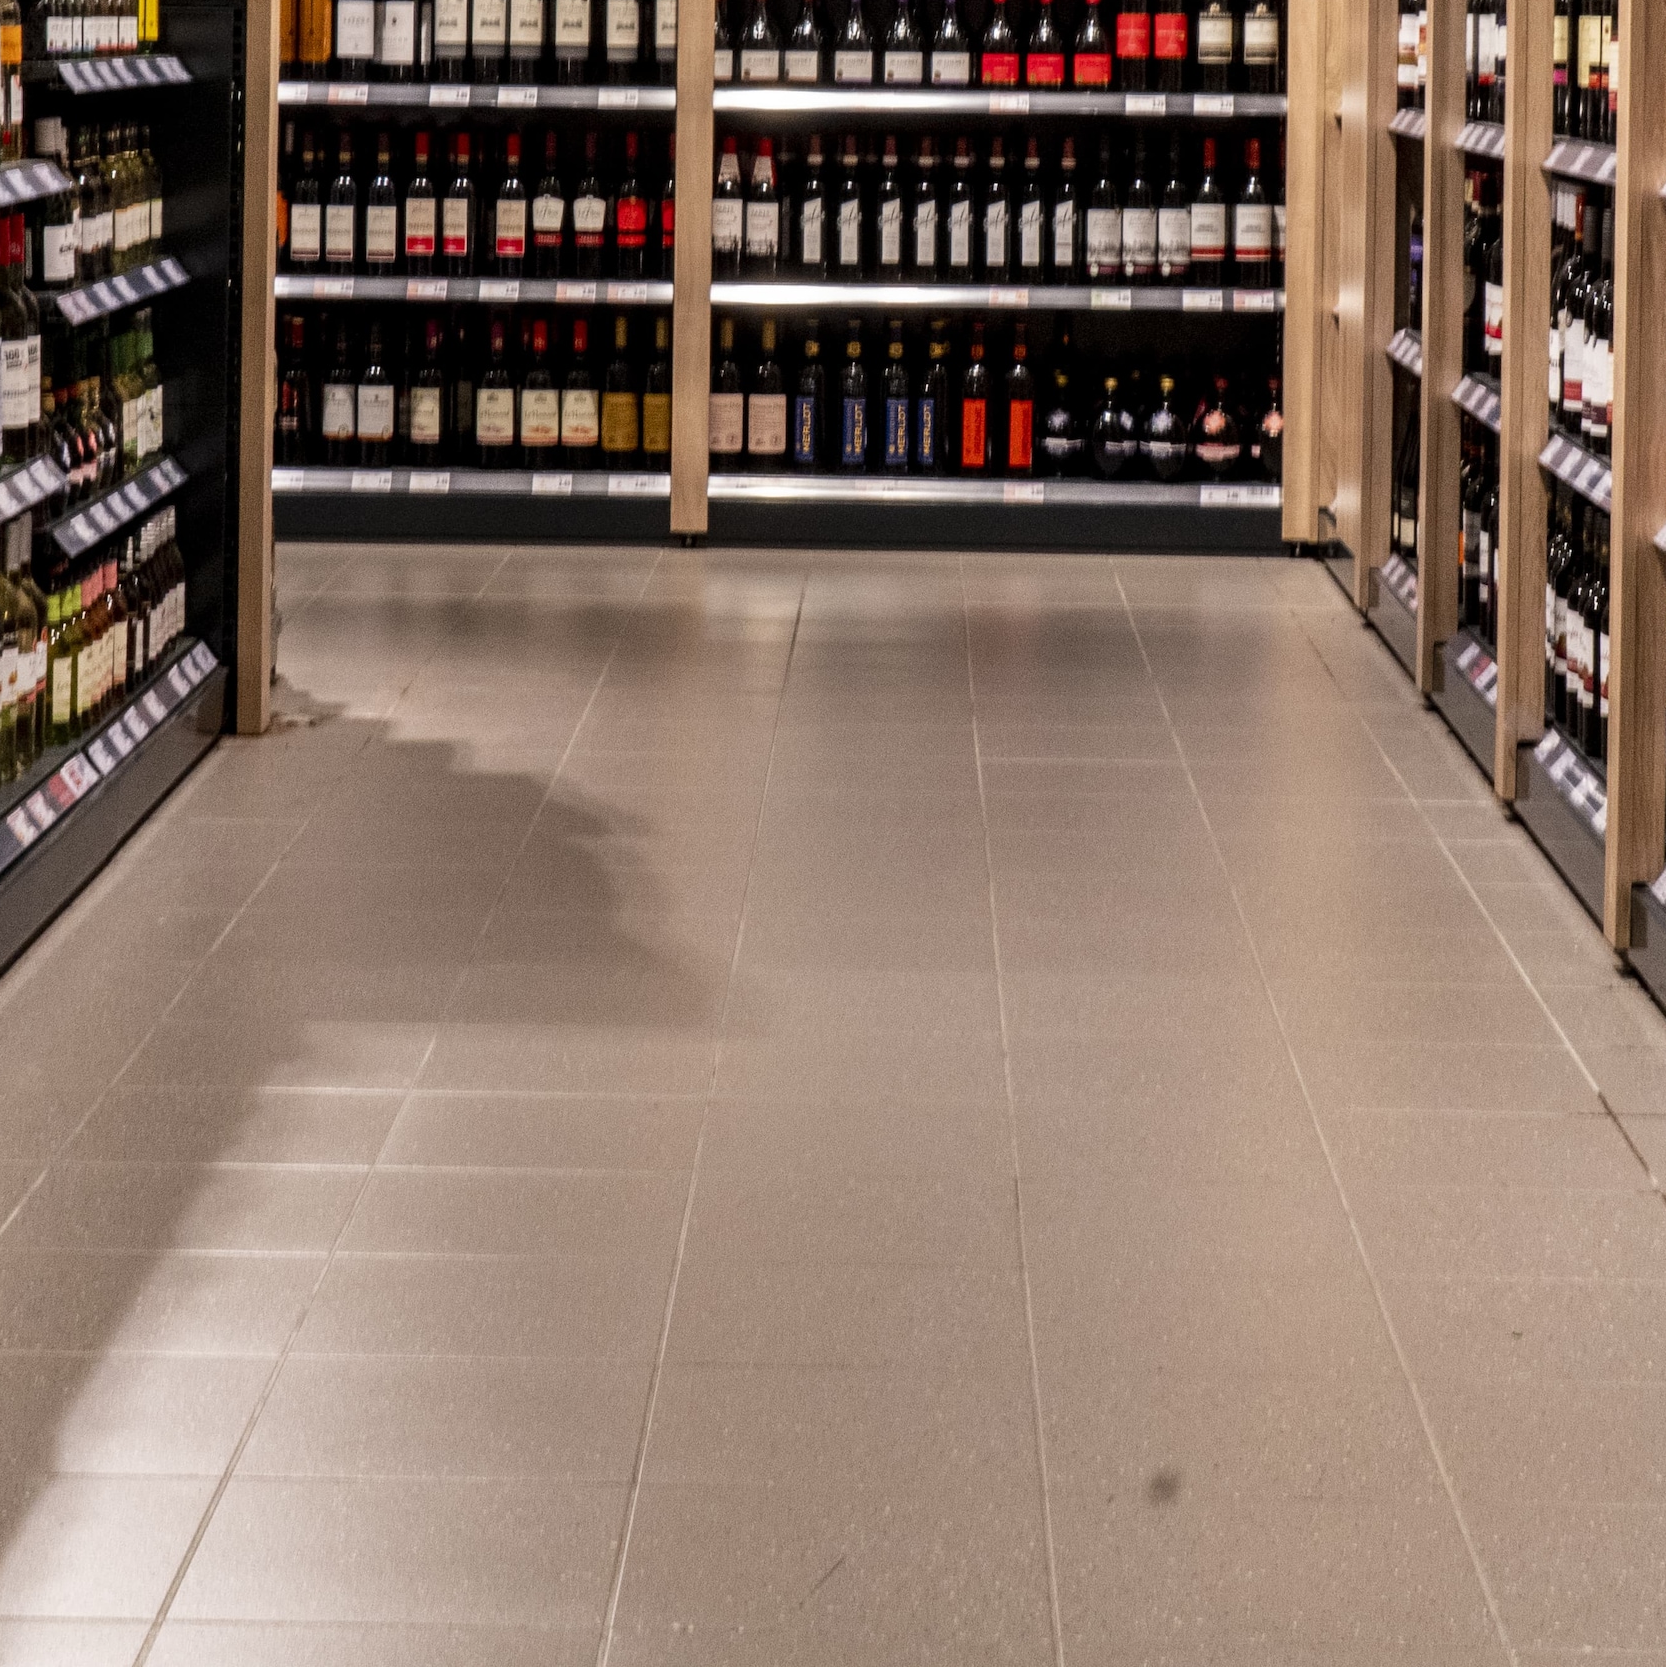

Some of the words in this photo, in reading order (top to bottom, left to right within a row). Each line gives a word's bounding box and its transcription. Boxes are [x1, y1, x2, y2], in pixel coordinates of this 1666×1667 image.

[802, 403, 812, 453] MERLOT
[853, 404, 863, 455] MERLOT
[897, 405, 906, 455] MERLOT
[922, 405, 932, 455] MERLOT
